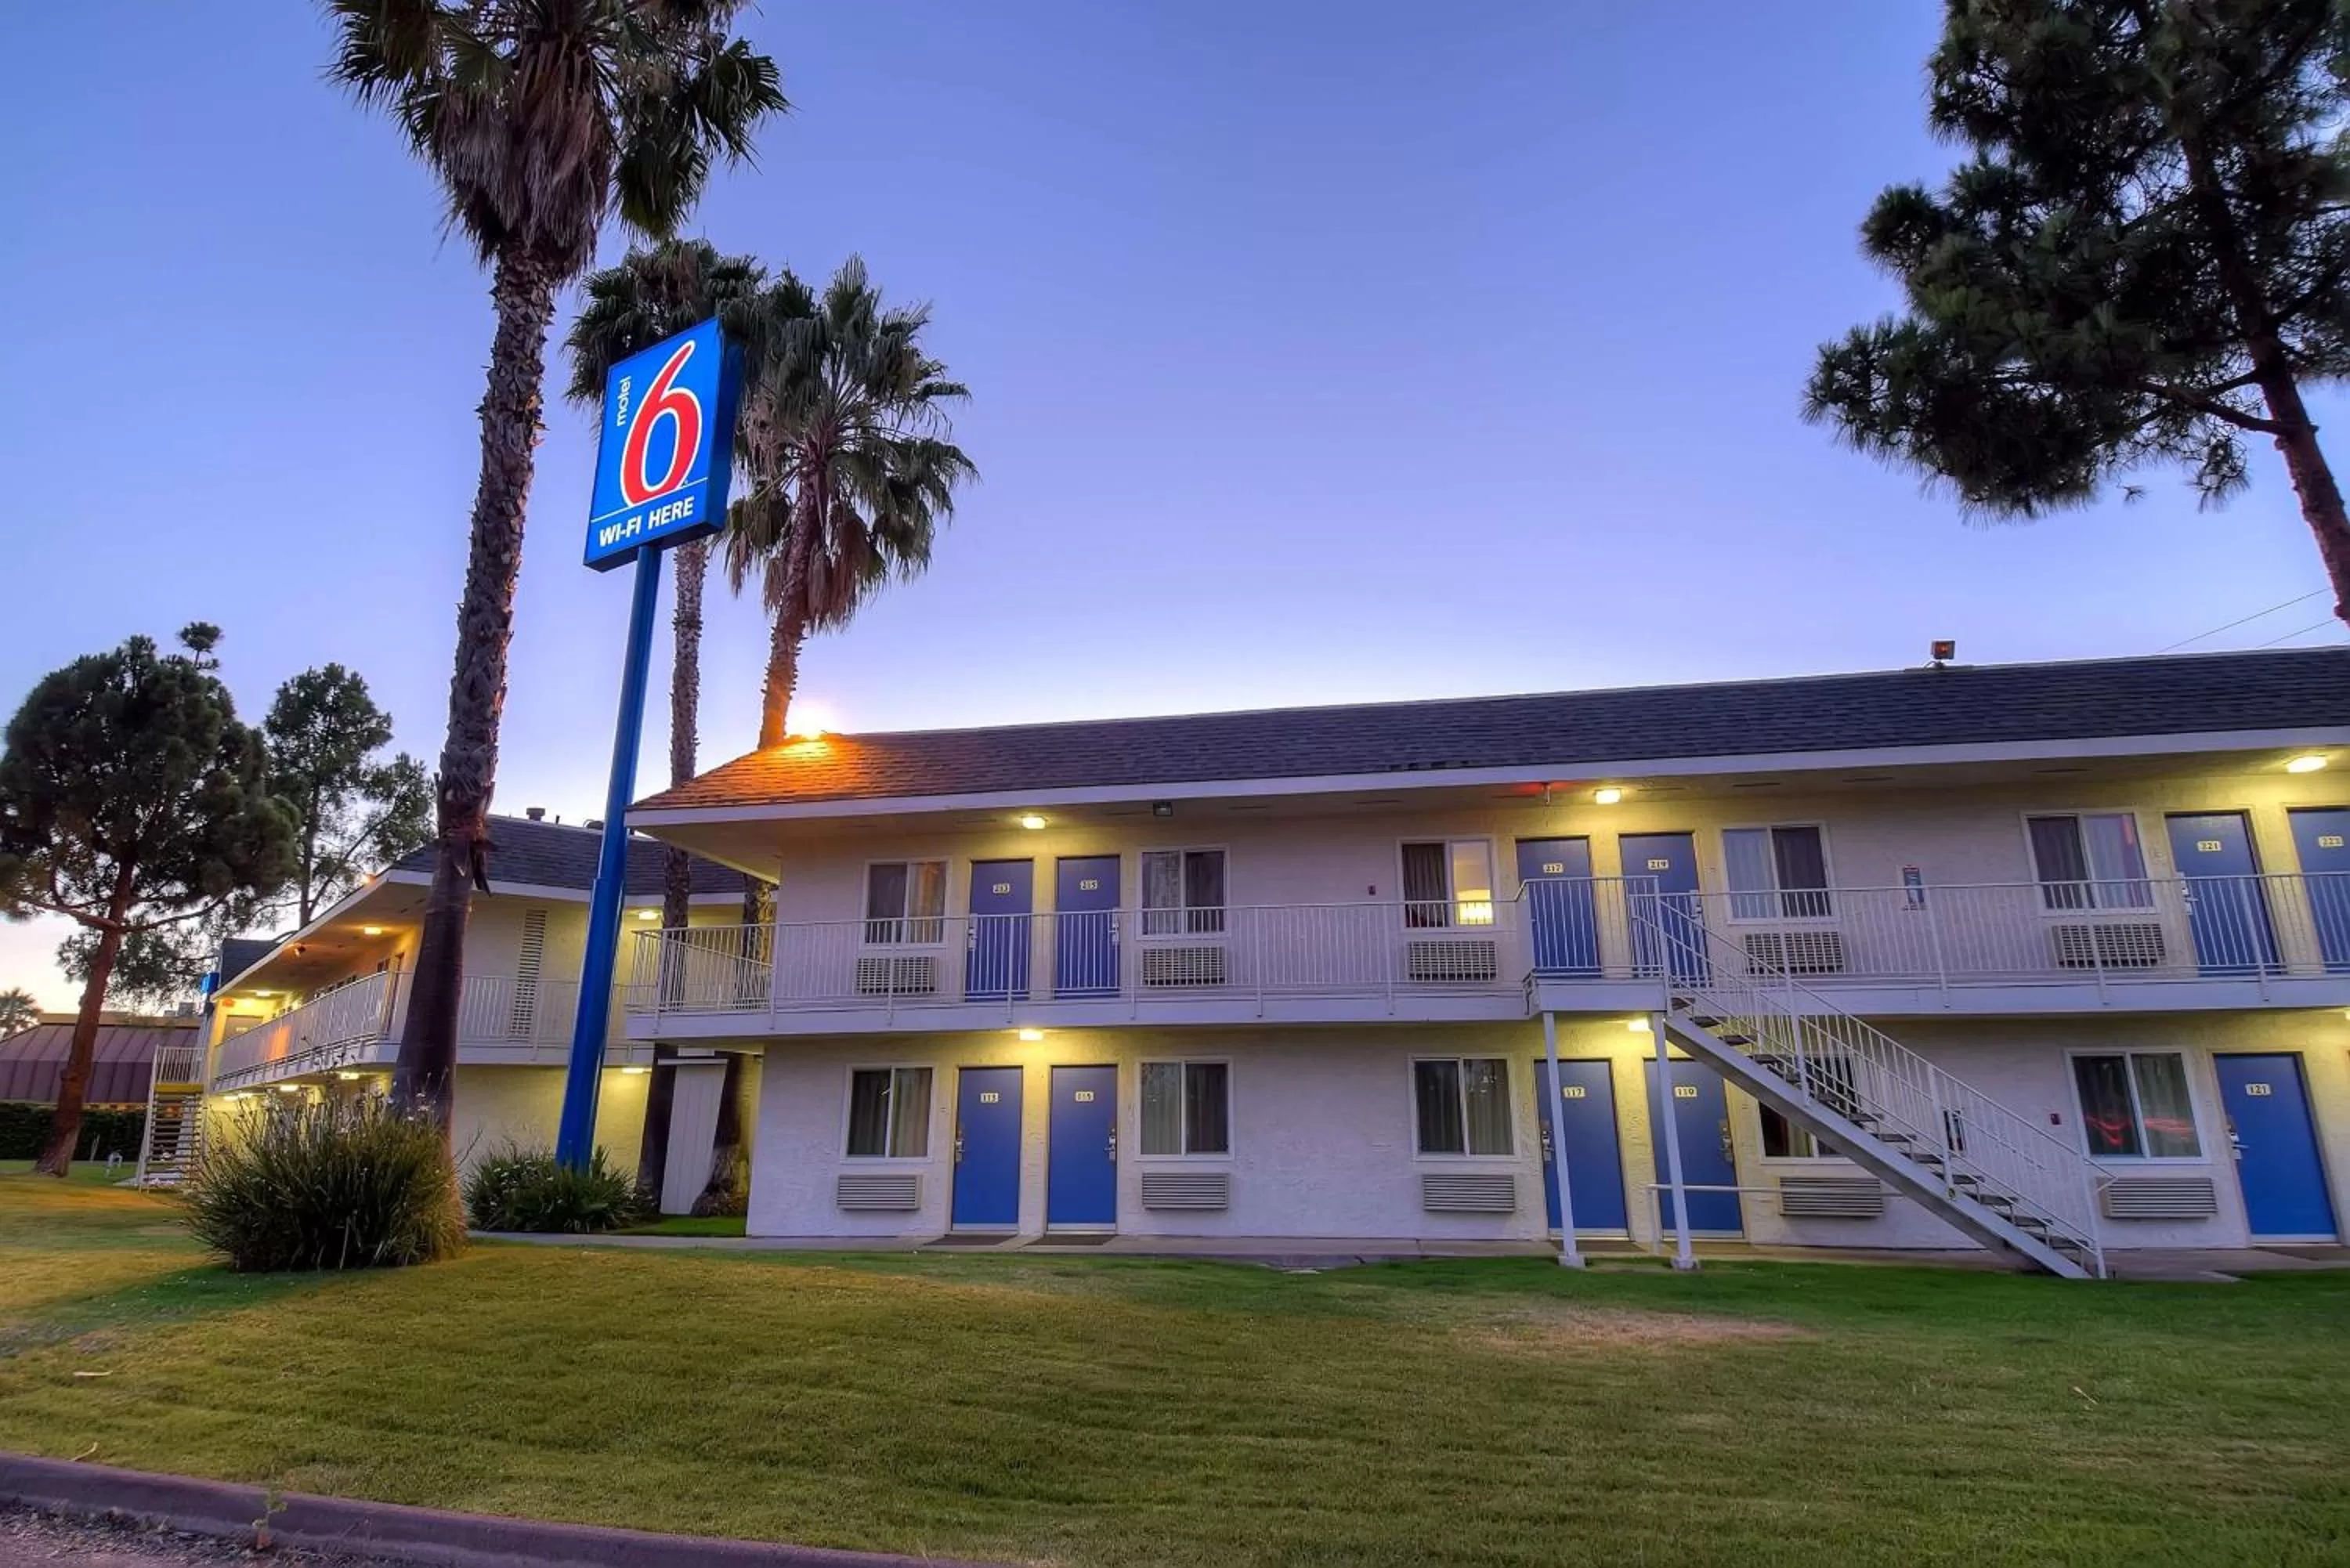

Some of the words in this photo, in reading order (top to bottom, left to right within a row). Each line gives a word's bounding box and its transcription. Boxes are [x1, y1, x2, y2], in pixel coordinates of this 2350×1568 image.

[616, 375, 632, 427] motel
[620, 339, 702, 508] 6
[599, 515, 642, 547] WI-FI
[648, 495, 695, 530] HERE
